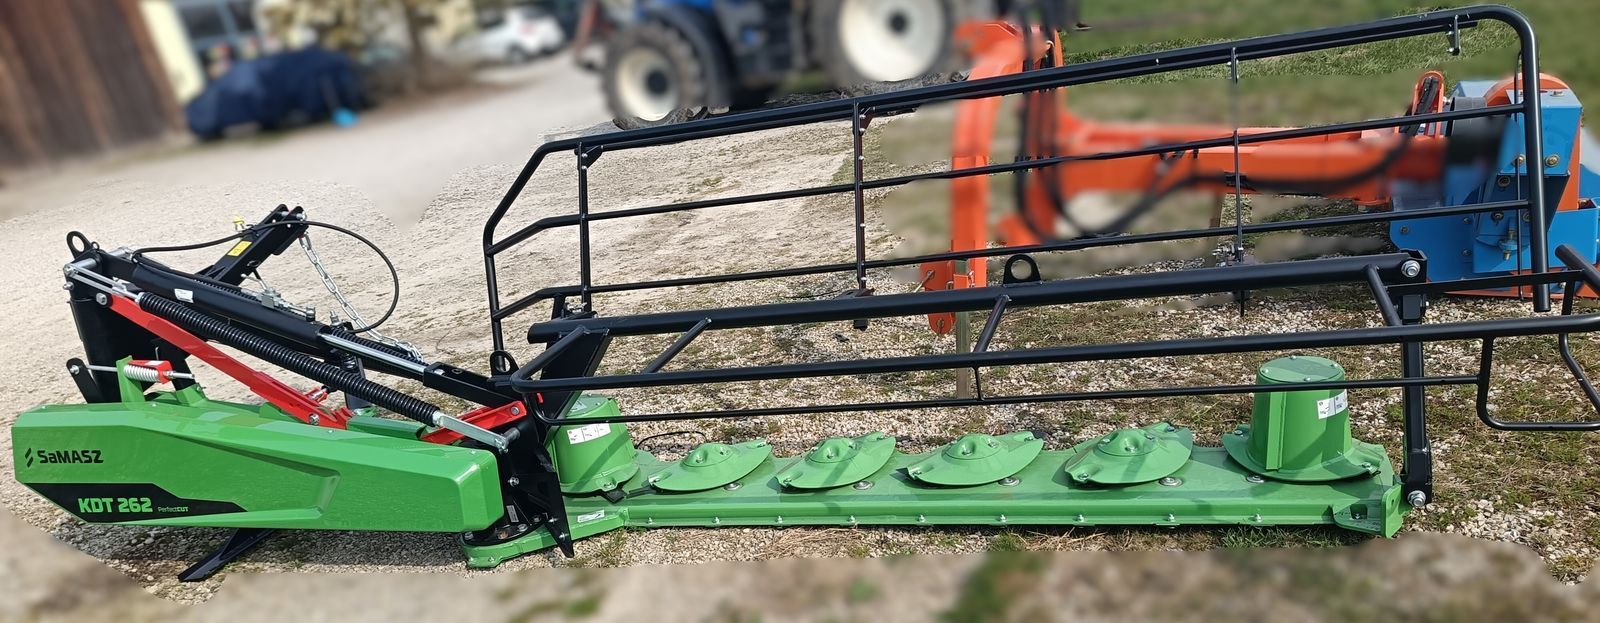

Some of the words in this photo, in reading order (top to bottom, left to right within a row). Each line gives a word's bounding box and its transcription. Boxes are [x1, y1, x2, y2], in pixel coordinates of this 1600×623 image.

[37, 450, 104, 464] SaMASZ
[78, 498, 114, 513] KDT
[118, 498, 153, 513] 262
